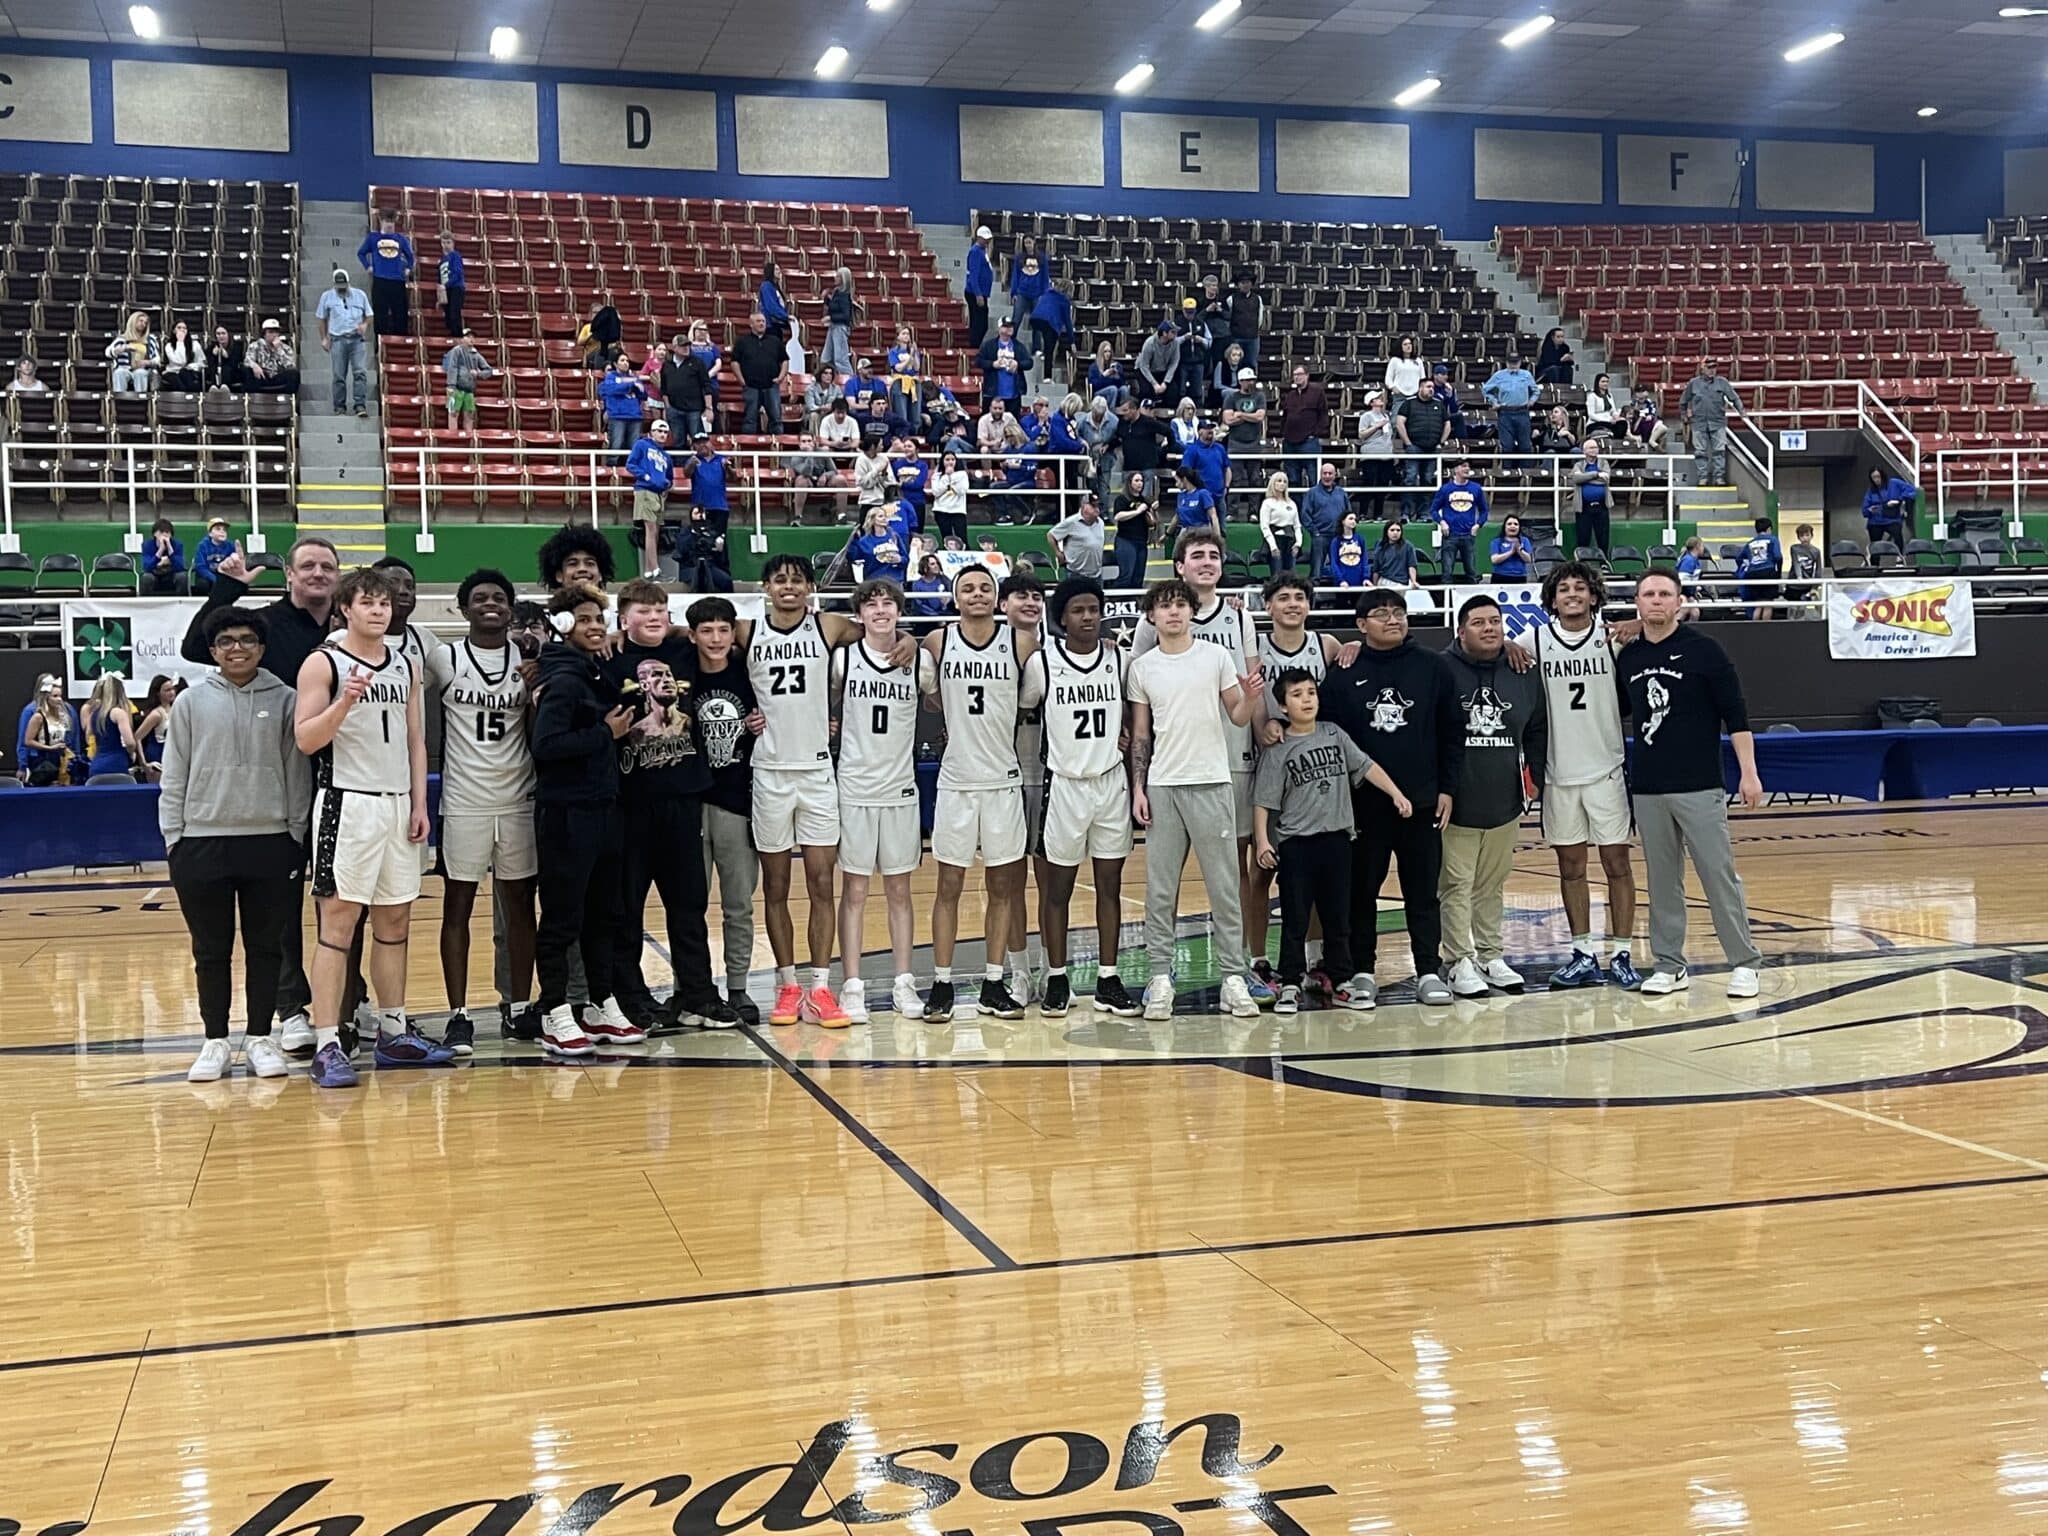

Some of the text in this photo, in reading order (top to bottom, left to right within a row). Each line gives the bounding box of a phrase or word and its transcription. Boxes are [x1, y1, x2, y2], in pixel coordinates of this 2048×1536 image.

[626, 105, 651, 149] D
[1180, 131, 1201, 173] E
[1670, 152, 1688, 191] F
[336, 434, 343, 444] 3
[339, 468, 345, 478] 2
[1103, 601, 1141, 616] CKL
[1855, 599, 1947, 624] SONIC
[136, 637, 176, 661] Cogdell
[1864, 632, 1917, 642] America's
[753, 641, 819, 663] RANDALL
[944, 661, 1010, 680] RANDALL
[1543, 657, 1608, 678] RANDALL
[769, 665, 806, 696] 23
[849, 680, 911, 700] RANDALL
[359, 683, 408, 704] ANDAL
[967, 685, 984, 715] 3
[1056, 684, 1116, 705] RANDALL
[1569, 682, 1587, 710] 2
[381, 710, 389, 743] 1
[476, 711, 505, 742] 15
[872, 705, 888, 734] 0
[1073, 709, 1106, 739] 20
[1465, 737, 1514, 747] ASKETBALL
[1286, 745, 1344, 774] RAIDER
